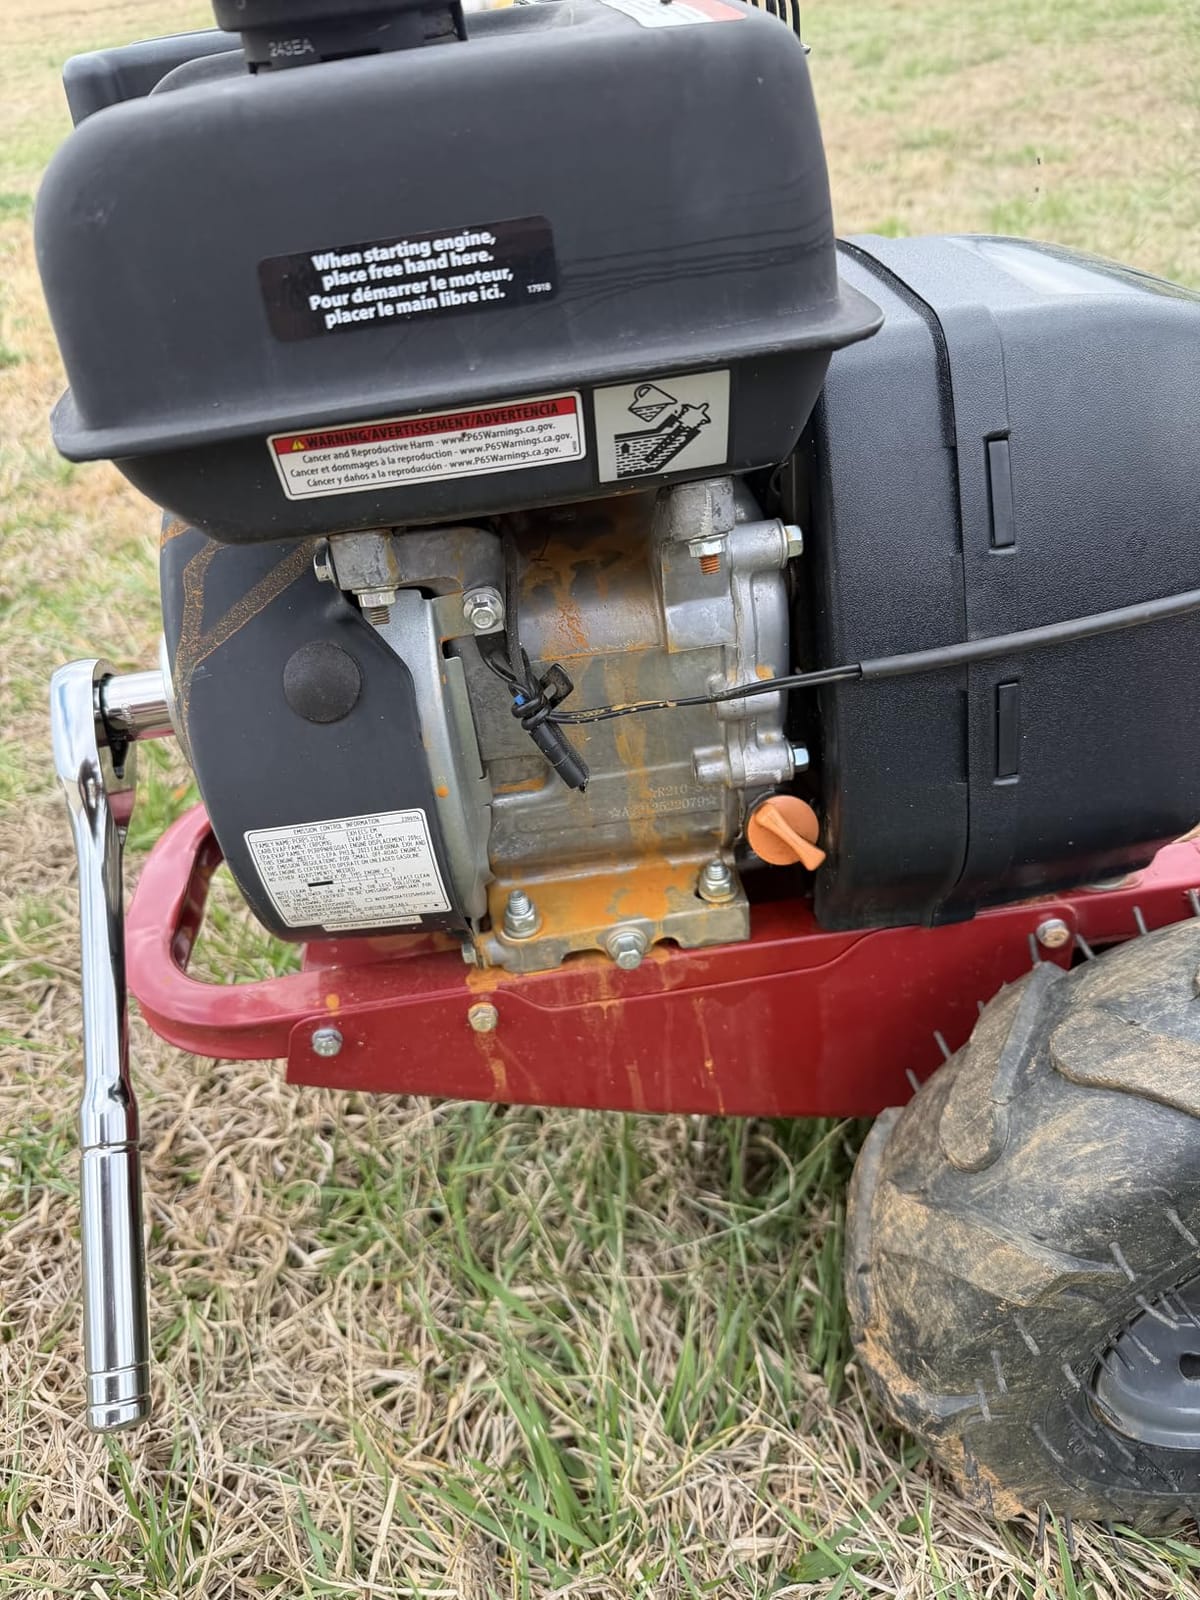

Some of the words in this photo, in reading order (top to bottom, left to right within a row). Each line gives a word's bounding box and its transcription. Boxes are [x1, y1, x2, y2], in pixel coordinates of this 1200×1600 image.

[311, 252, 362, 271] When
[363, 240, 432, 262] starting
[432, 231, 496, 252] engine,
[322, 270, 367, 291] place
[367, 263, 403, 280] free
[403, 252, 449, 274] hand
[449, 250, 494, 267] here.
[309, 293, 349, 311] Pour
[351, 281, 428, 303] démarrer
[429, 275, 447, 291] le
[448, 268, 514, 288] moteur,
[324, 308, 376, 329] placer
[377, 301, 394, 317] le
[395, 295, 438, 314] main
[438, 290, 479, 307] libre
[480, 283, 506, 301] ici.
[302, 453, 331, 464] Cancer
[333, 451, 350, 460] and
[351, 443, 409, 458] Reproductive
[410, 440, 434, 449] Harm
[441, 422, 556, 446] www.P65Warnings.ca.gov.
[306, 403, 559, 448] WARNING/AVERTISSEMENT/ADVERTENCIA
[290, 468, 319, 478] Cancer
[320, 466, 330, 474] et
[331, 460, 379, 474] dommages
[387, 456, 396, 465] la
[397, 449, 453, 467] reproduction
[459, 433, 573, 455] www.P65Warnings.ca.gov.
[307, 476, 335, 487] Cáncer
[337, 477, 342, 485] y
[344, 472, 370, 482] daños
[371, 472, 376, 480] a
[378, 469, 386, 478] la
[387, 463, 443, 479] reproducción
[449, 447, 561, 469] www.P65Warnings.ca.gov.
[346, 819, 380, 827] INFORMATION
